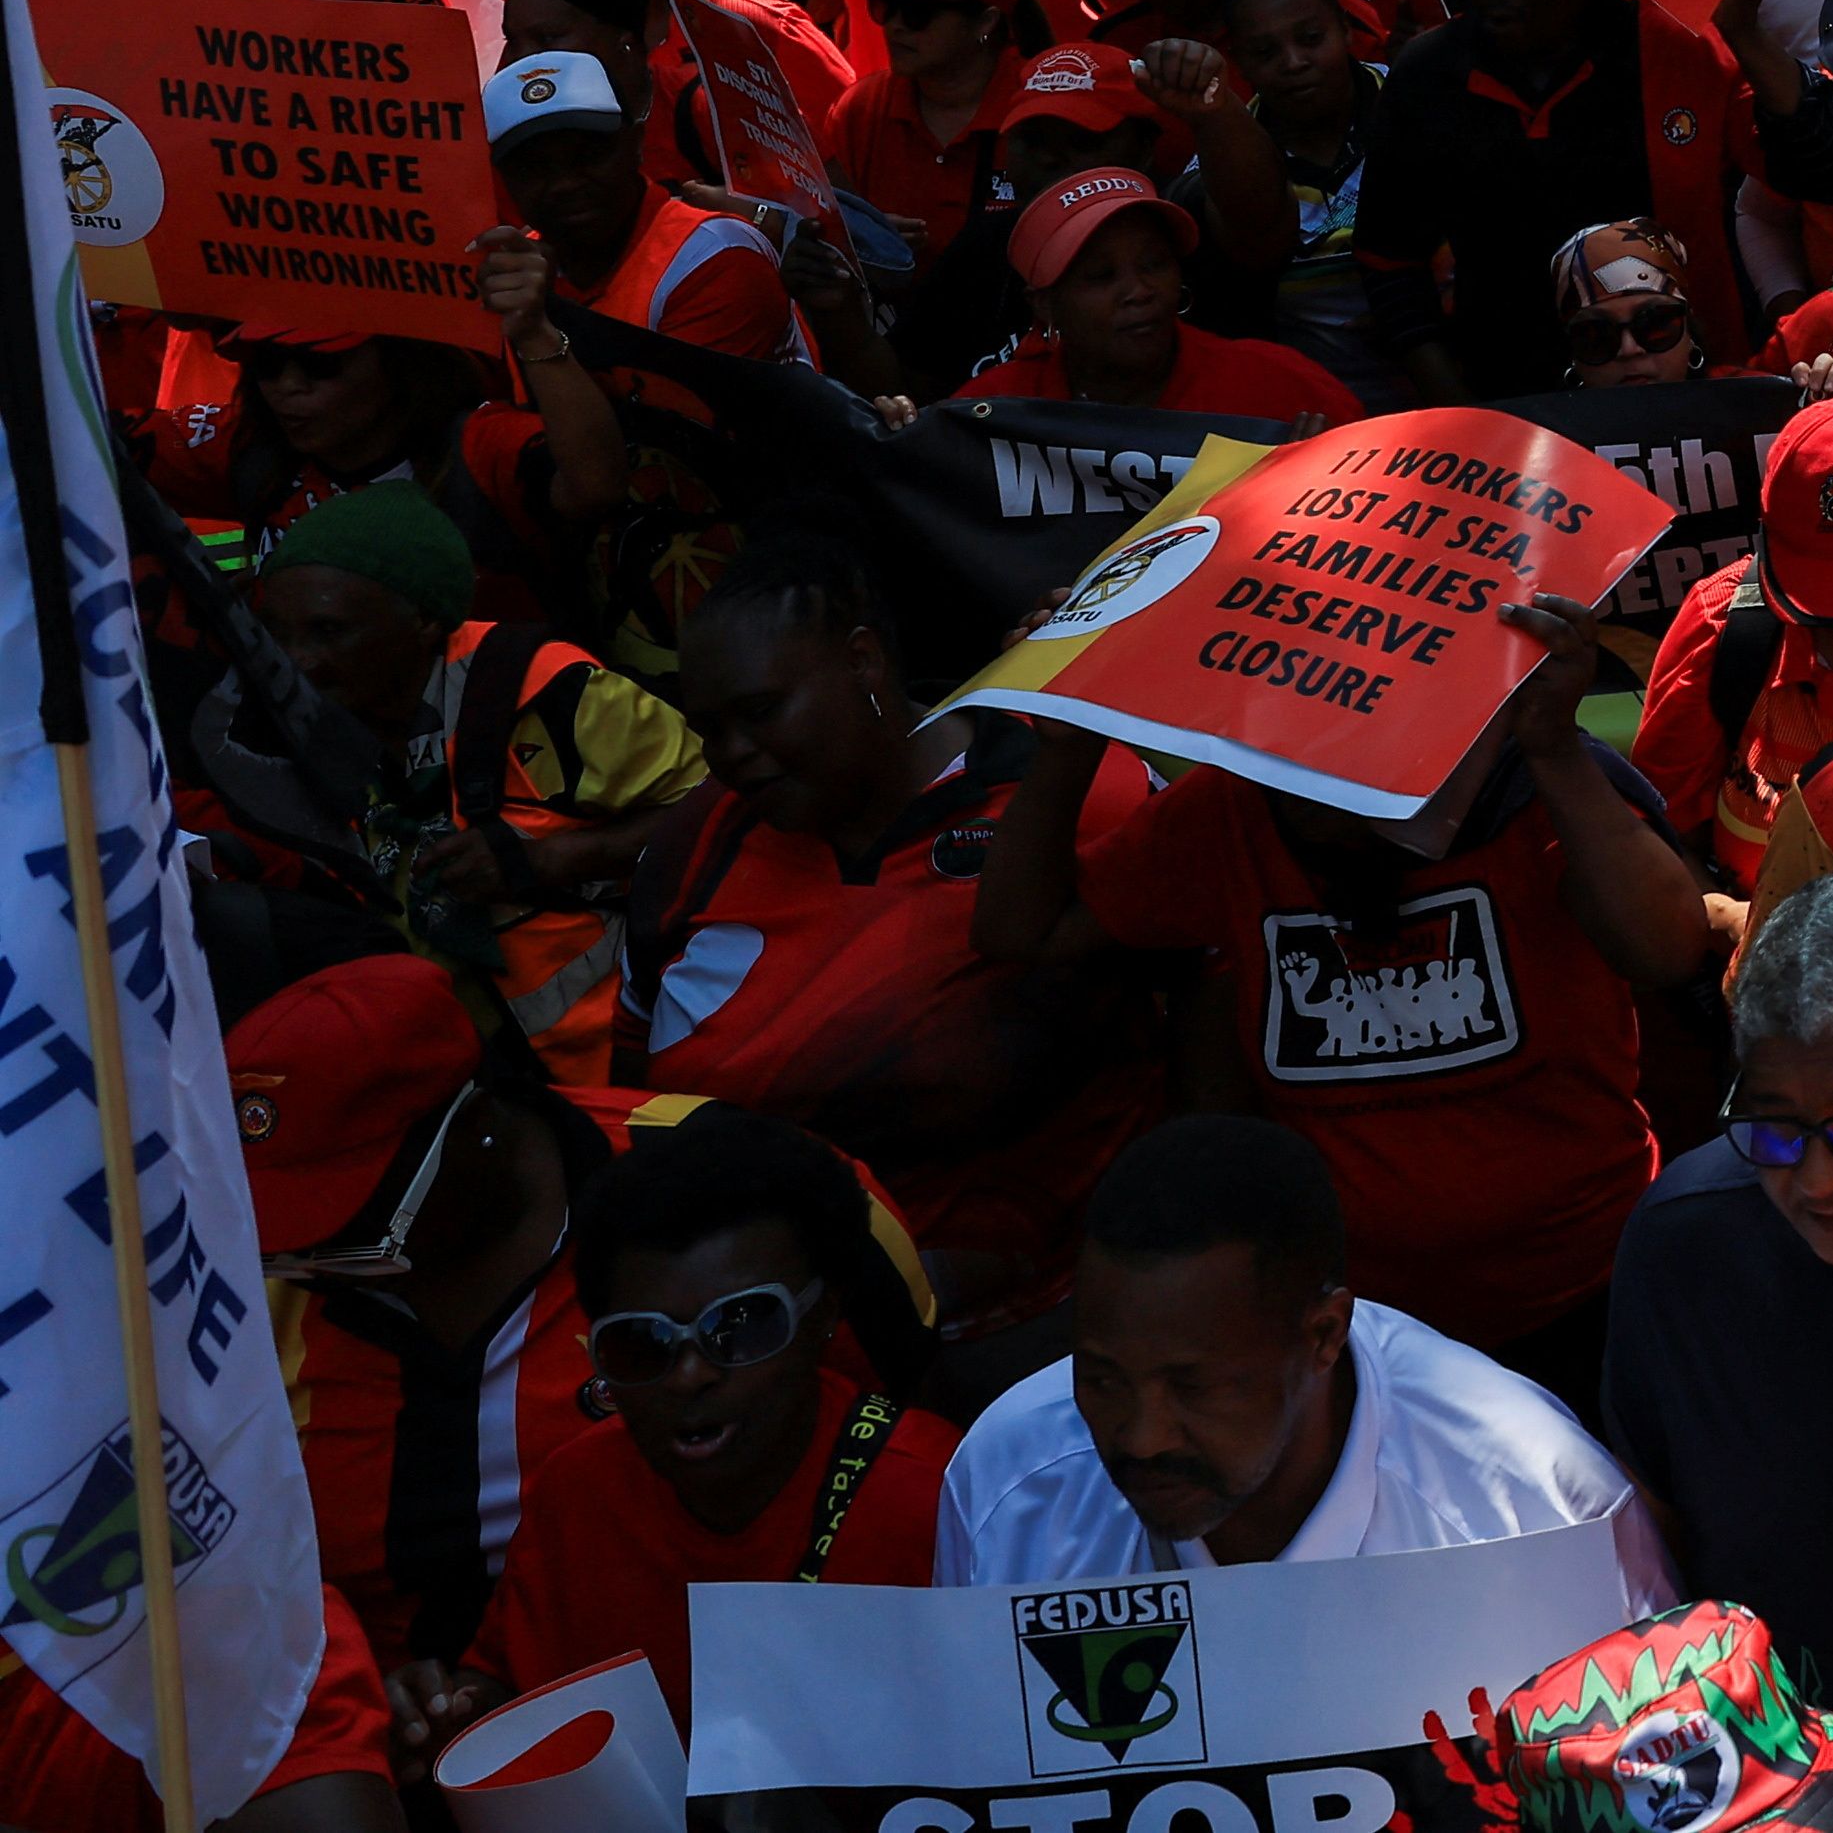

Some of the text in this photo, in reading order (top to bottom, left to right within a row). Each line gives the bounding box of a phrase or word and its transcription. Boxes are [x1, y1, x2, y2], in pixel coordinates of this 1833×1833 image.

[194, 23, 411, 85] WORKERS
[159, 77, 467, 143] HAVE A RIGHT
[209, 137, 424, 197] TO SAFE
[1058, 176, 1144, 209] REDD'S
[216, 189, 436, 248] WORKING
[1284, 487, 1451, 540] LOST AT
[1330, 446, 1595, 536] 11 WORKERS
[1251, 529, 1501, 615] FAMILIES
[1215, 575, 1457, 667] DESERVE
[1198, 629, 1396, 715] CLOSURE
[1012, 1580, 1193, 1634] FEDUSA
